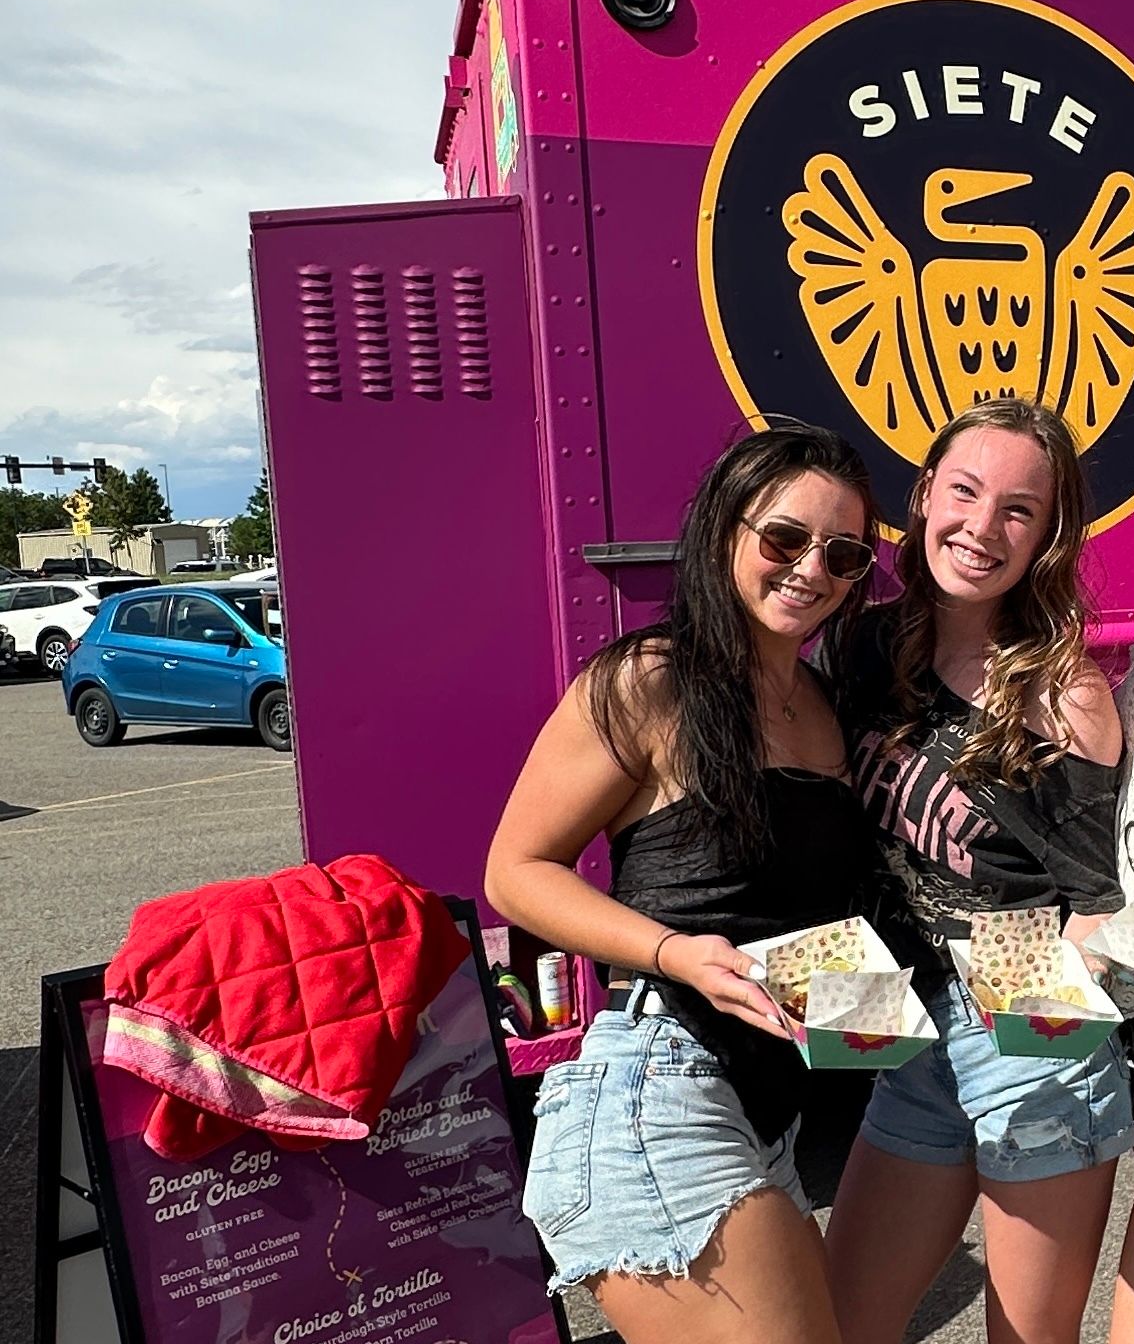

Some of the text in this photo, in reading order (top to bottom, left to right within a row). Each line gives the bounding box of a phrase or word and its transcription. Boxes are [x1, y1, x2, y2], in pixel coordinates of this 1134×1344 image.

[847, 63, 1098, 155] SIETE
[366, 1107, 492, 1156] Refried Beans
[376, 1083, 475, 1134] Potato and
[146, 1150, 279, 1205] Bacon, Egg,
[407, 1153, 471, 1178] VEGETARIAN
[154, 1173, 282, 1223] and Cheese
[430, 1204, 451, 1219] and
[451, 1195, 471, 1211] Red
[185, 1208, 265, 1241] GLUTEN FREE
[387, 1232, 412, 1250] with
[412, 1224, 439, 1241] Siete
[160, 1266, 205, 1286] Bacon,
[233, 1244, 258, 1262] and
[259, 1231, 301, 1252] Cheese
[169, 1245, 300, 1300] with Siete Traditional
[195, 1270, 282, 1309] Botana Sauce.
[348, 1293, 368, 1318] of
[372, 1267, 444, 1309] Tortilla
[376, 1309, 408, 1331] Style
[408, 1290, 452, 1316] Tortilla
[395, 1316, 438, 1341] Tortilla
